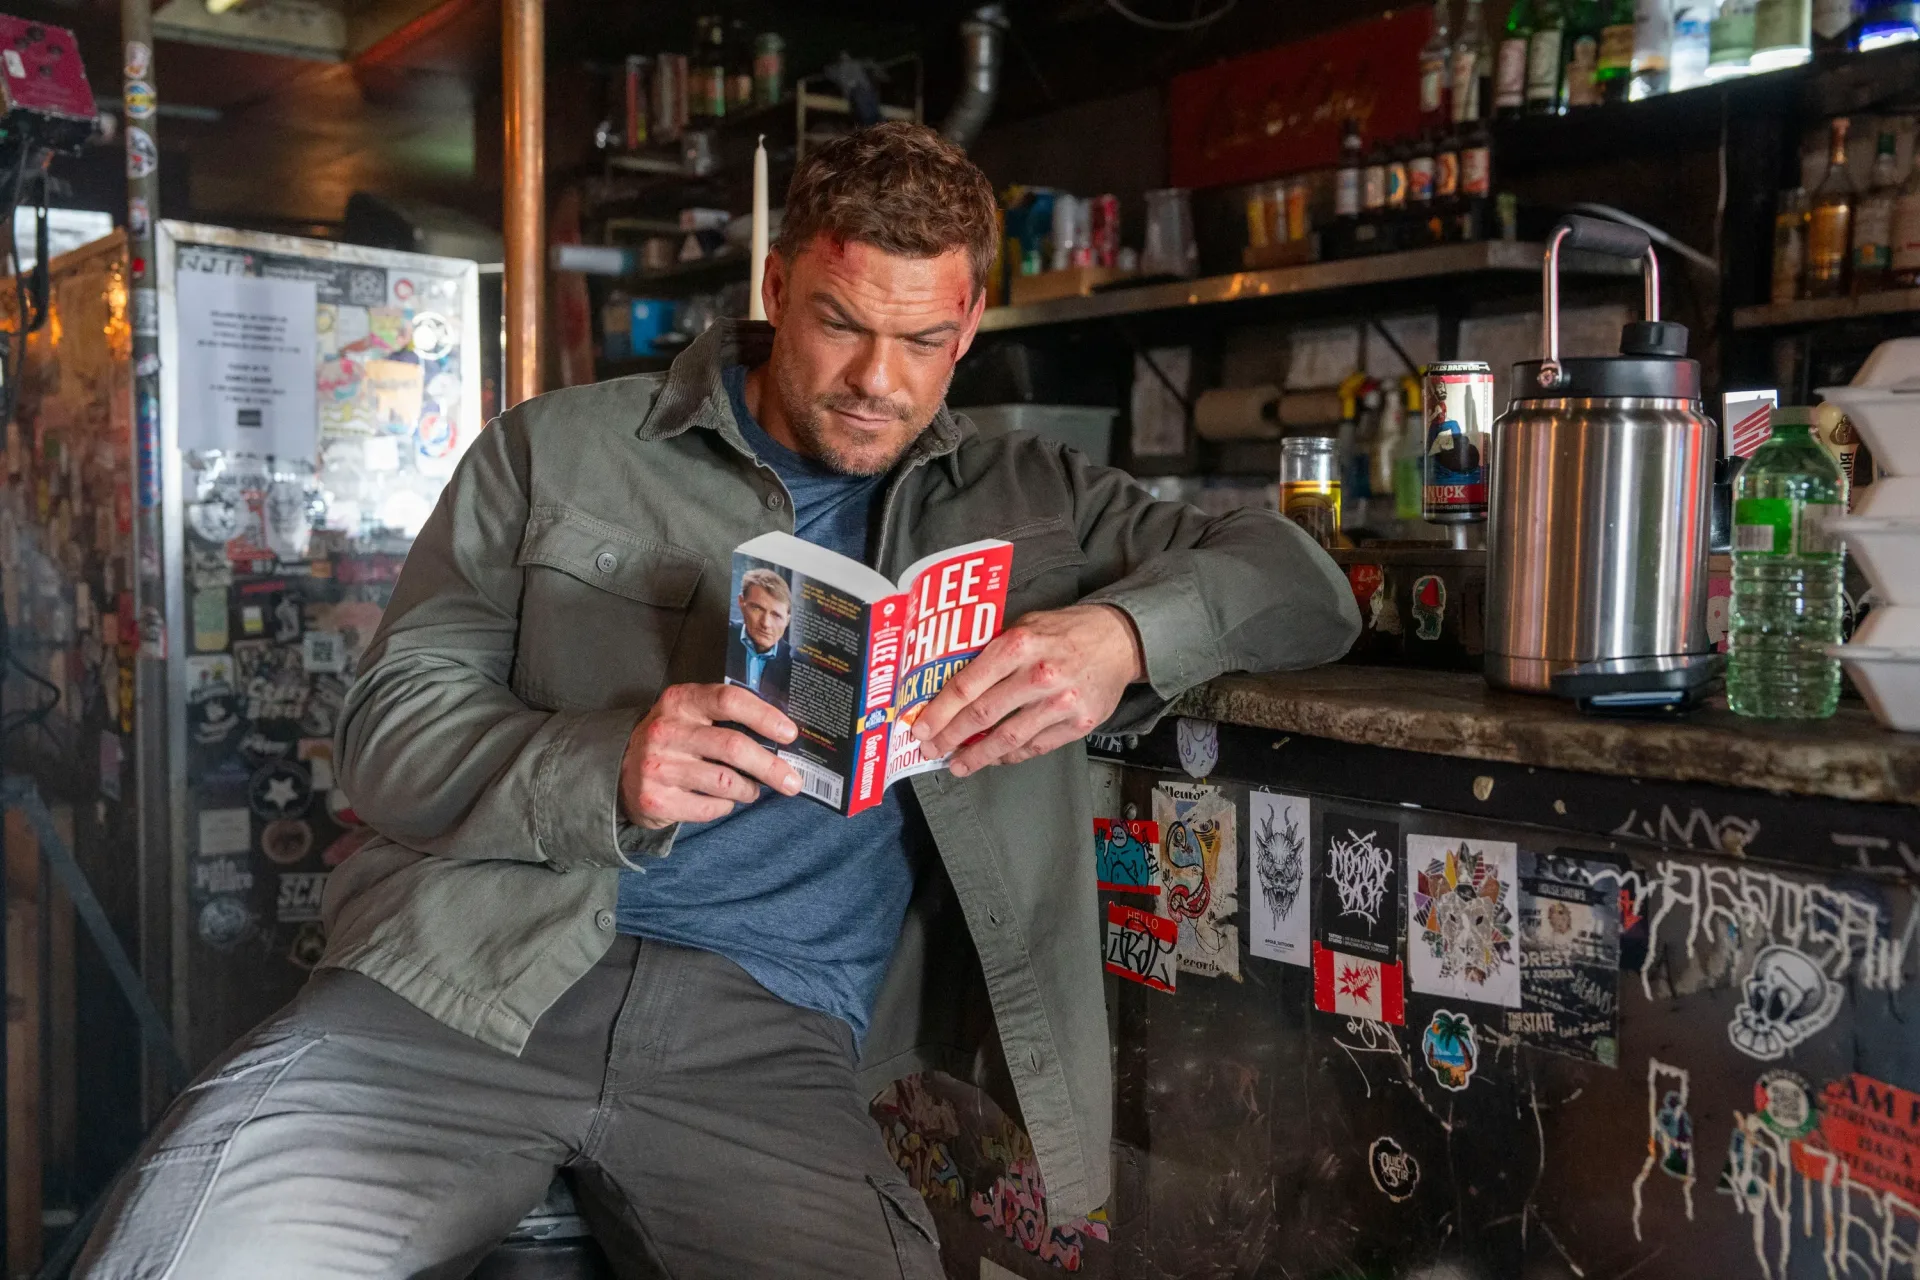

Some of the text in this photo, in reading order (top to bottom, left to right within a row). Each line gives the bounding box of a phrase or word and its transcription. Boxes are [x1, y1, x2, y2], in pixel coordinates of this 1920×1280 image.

[918, 557, 985, 622] LEE
[871, 638, 898, 667] LEE
[901, 602, 997, 678] CHILD
[866, 665, 895, 708] CHILD
[896, 672, 921, 714] ACK
[921, 658, 970, 696] REAC
[860, 734, 883, 800] Gone Tomorrow
[1127, 909, 1159, 930] HELLO
[1522, 1012, 1556, 1032] STATE
